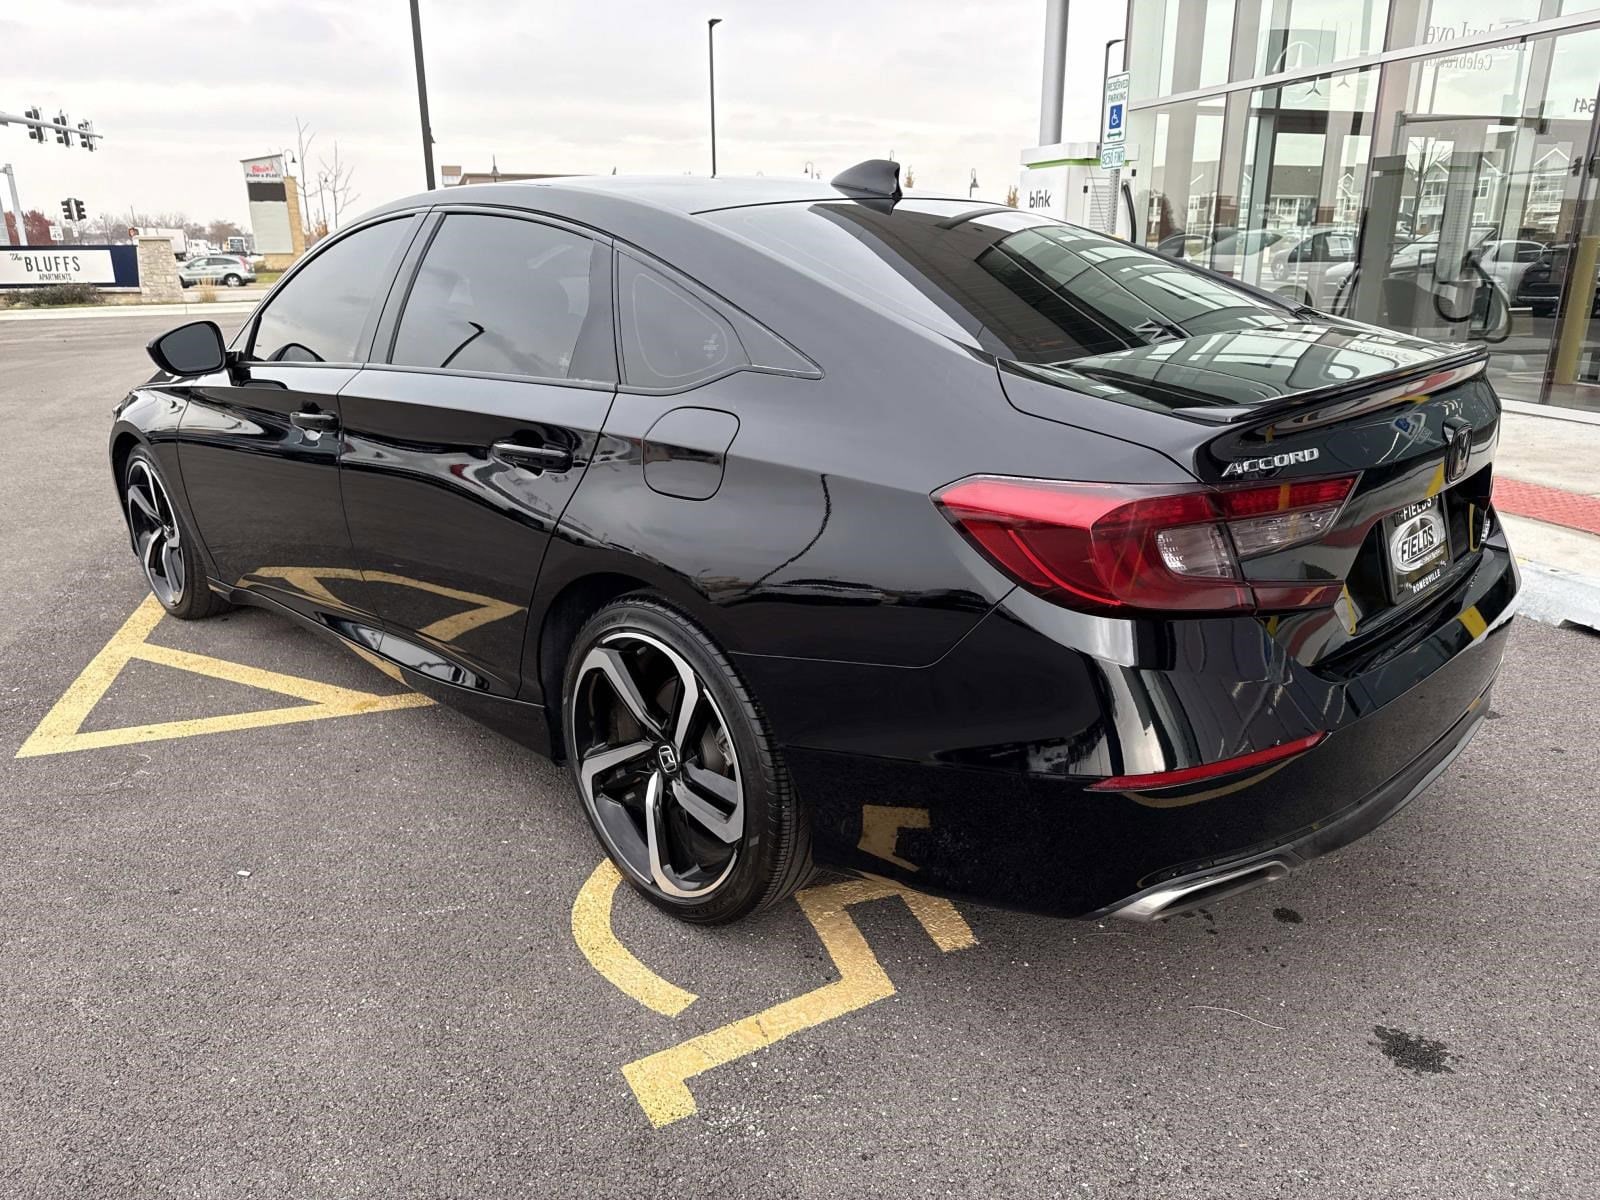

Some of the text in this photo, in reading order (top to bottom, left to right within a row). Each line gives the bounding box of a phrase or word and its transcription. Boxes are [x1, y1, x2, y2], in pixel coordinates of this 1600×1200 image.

[1029, 189, 1051, 208] blink
[10, 253, 81, 272] The BLUFFS
[39, 272, 72, 281] APARTMENTS
[1221, 446, 1320, 477] ACCORD
[1401, 525, 1435, 562] FIELDS
[1412, 568, 1441, 594] ROMEOVILLE
